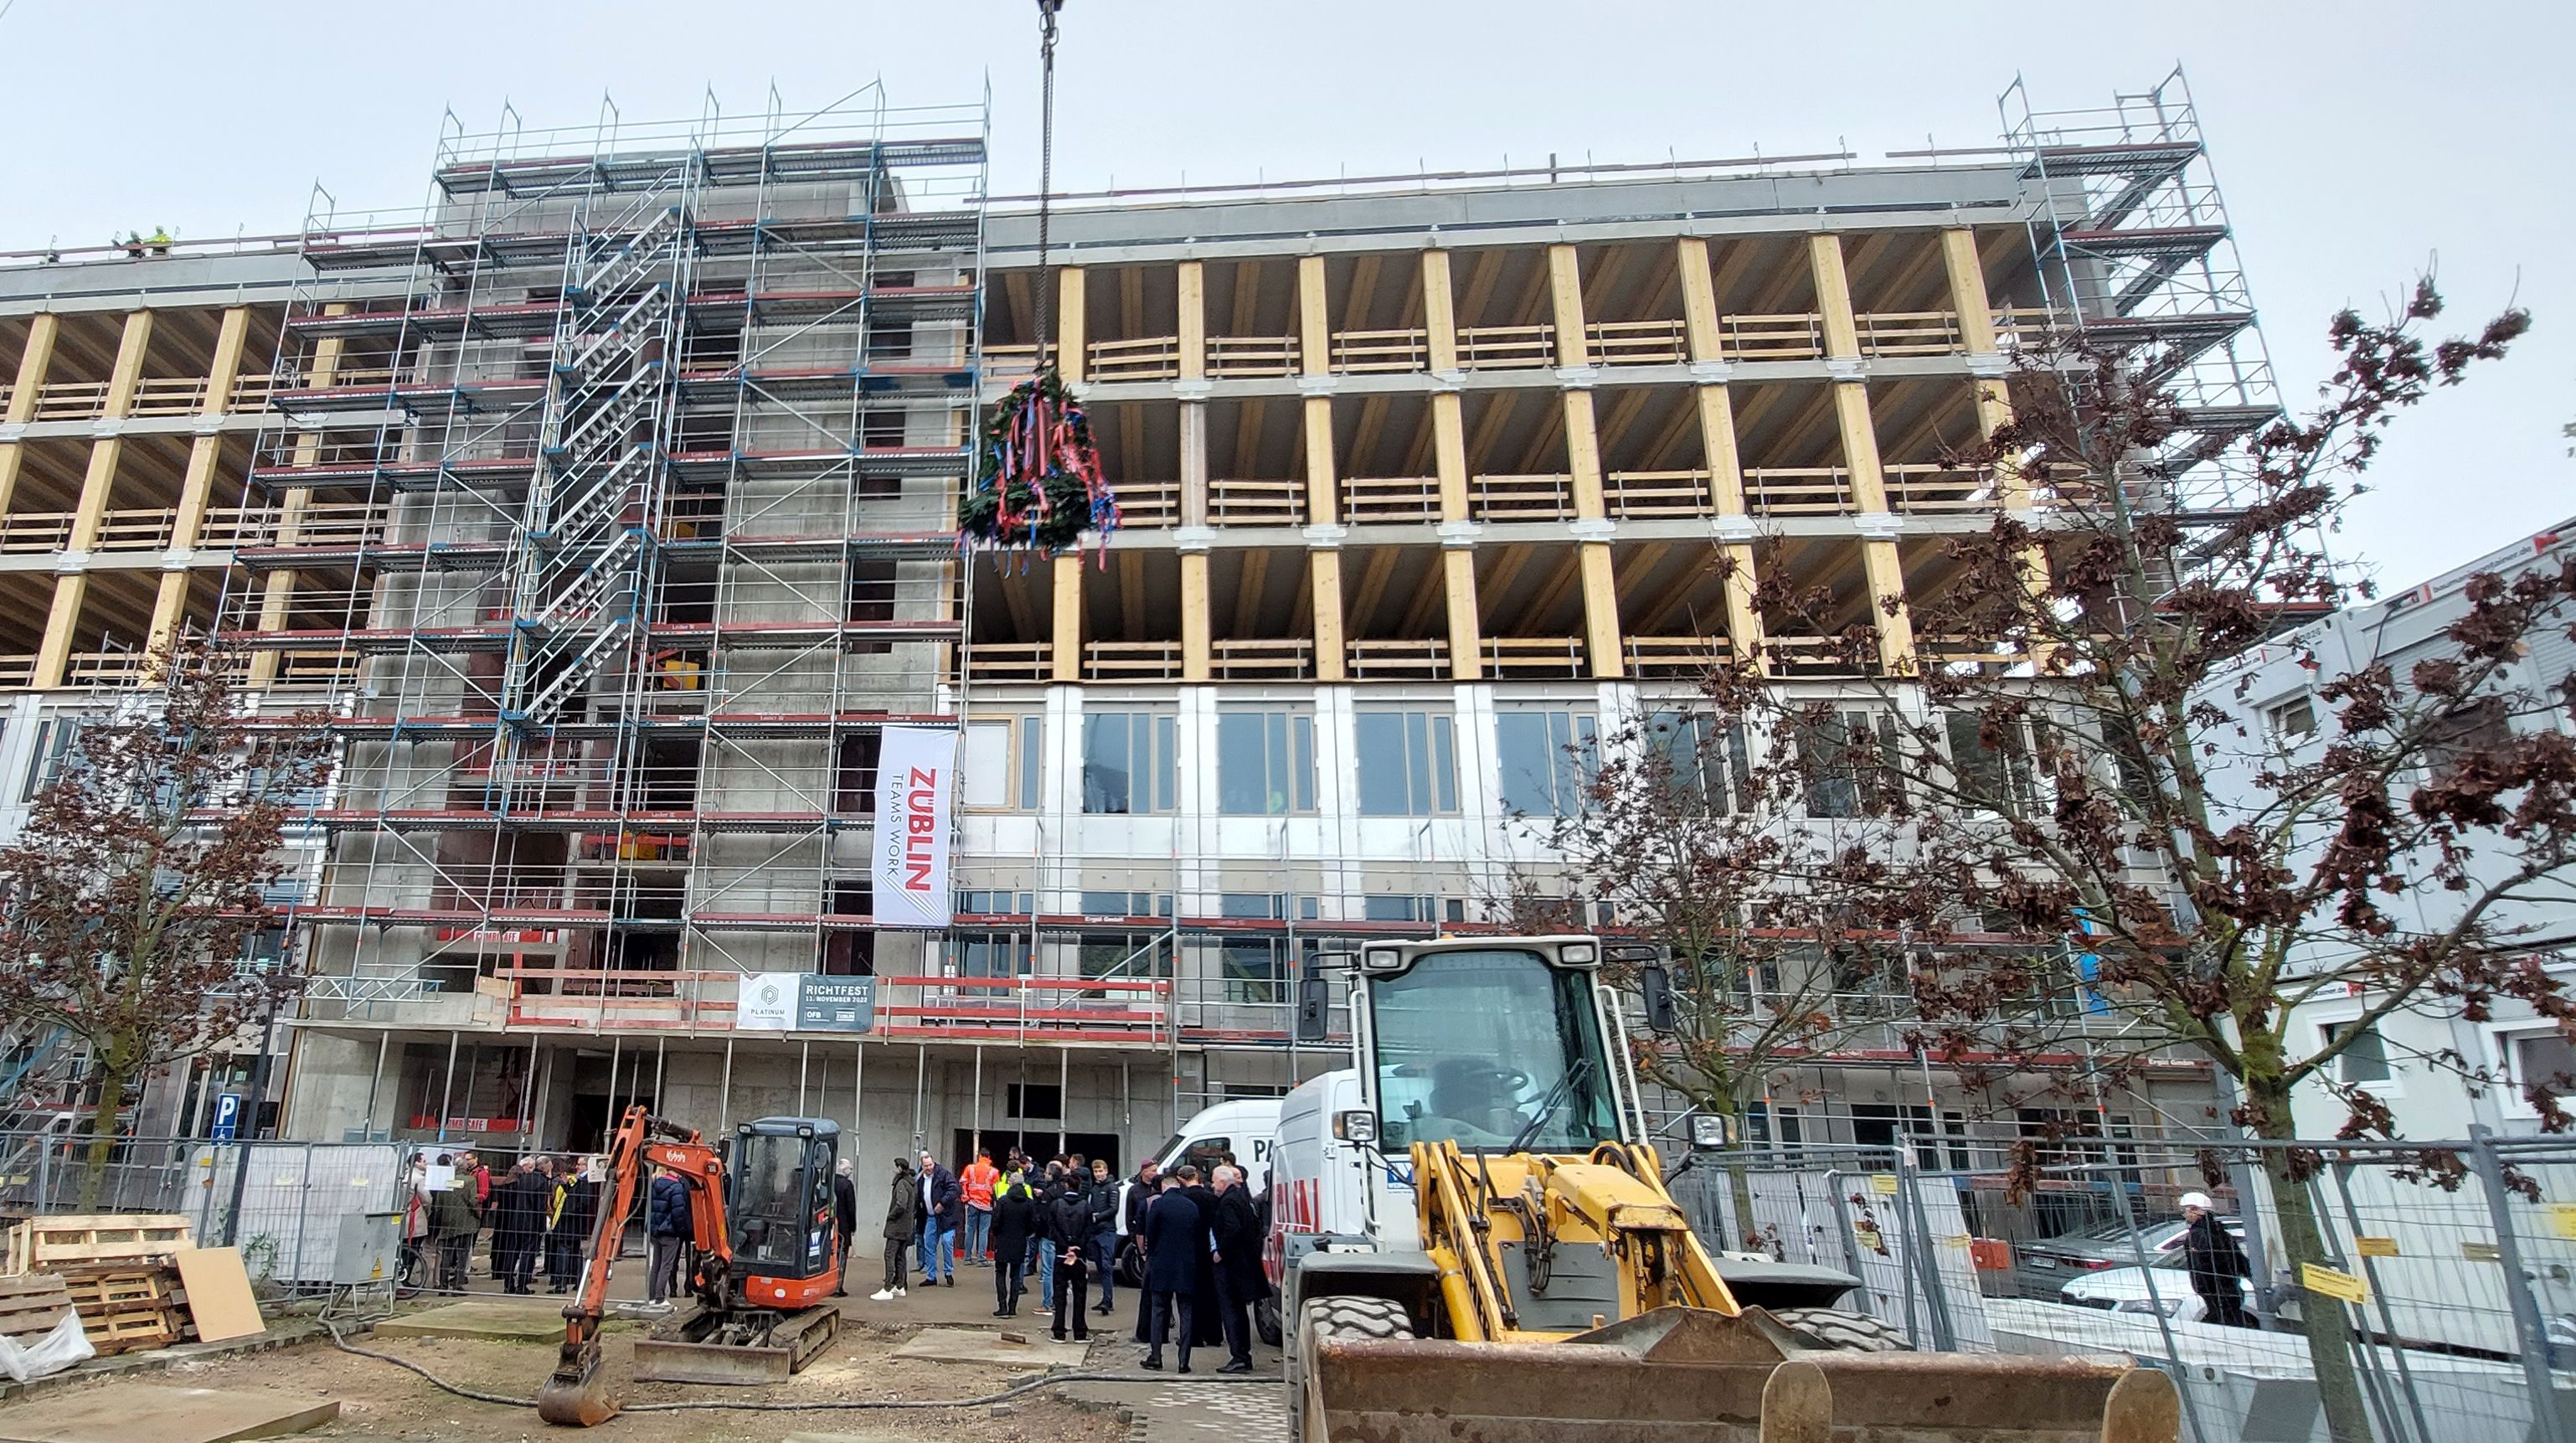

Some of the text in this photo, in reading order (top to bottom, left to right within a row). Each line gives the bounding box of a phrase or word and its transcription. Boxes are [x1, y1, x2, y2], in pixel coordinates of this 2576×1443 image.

[890, 774, 904, 823] TEAMS
[905, 765, 936, 891] ZÜBLIN
[806, 985, 868, 996] RICHTFEST
[218, 1097, 235, 1125] P
